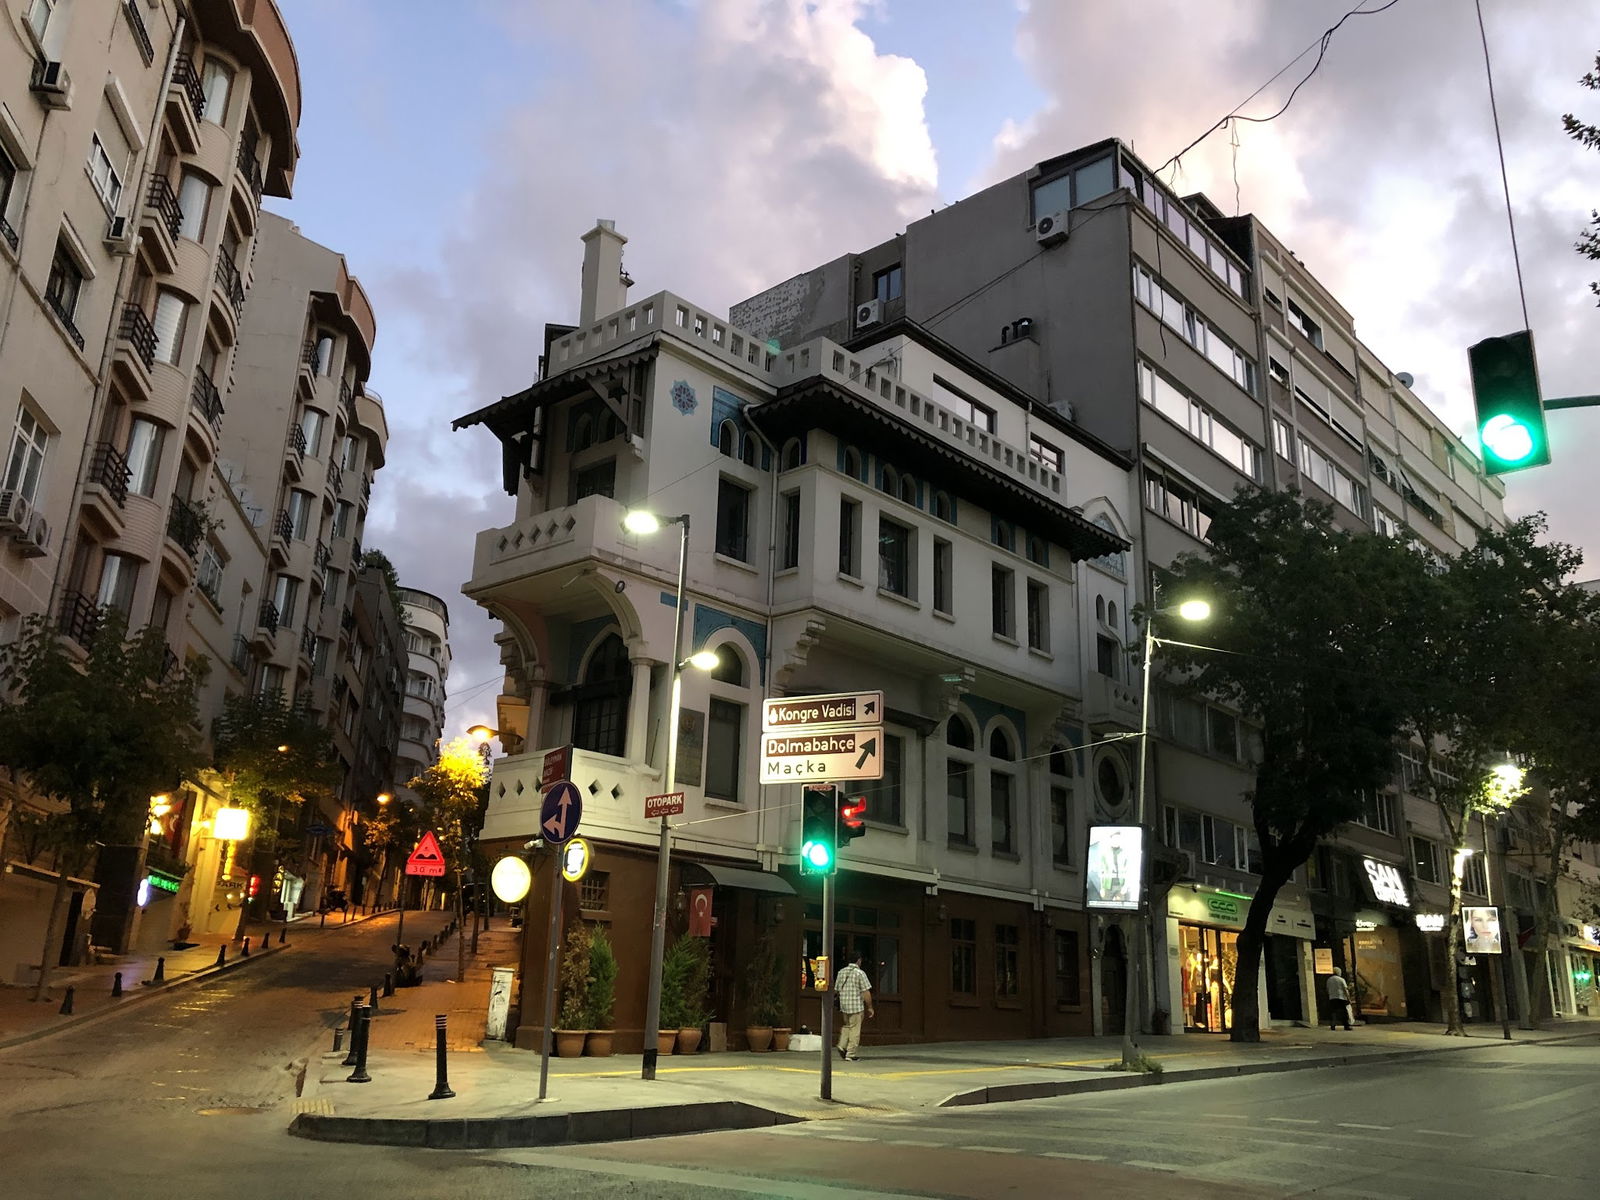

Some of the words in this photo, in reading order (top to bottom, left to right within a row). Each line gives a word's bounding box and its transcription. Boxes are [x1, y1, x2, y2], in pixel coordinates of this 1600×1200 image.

[778, 707, 819, 723] Kongre
[821, 703, 855, 718] Vadisi
[767, 736, 855, 754] Dolmabahçe
[767, 760, 827, 775] Maçka
[647, 794, 683, 809] OTOPARK
[1363, 859, 1405, 891] SAN
